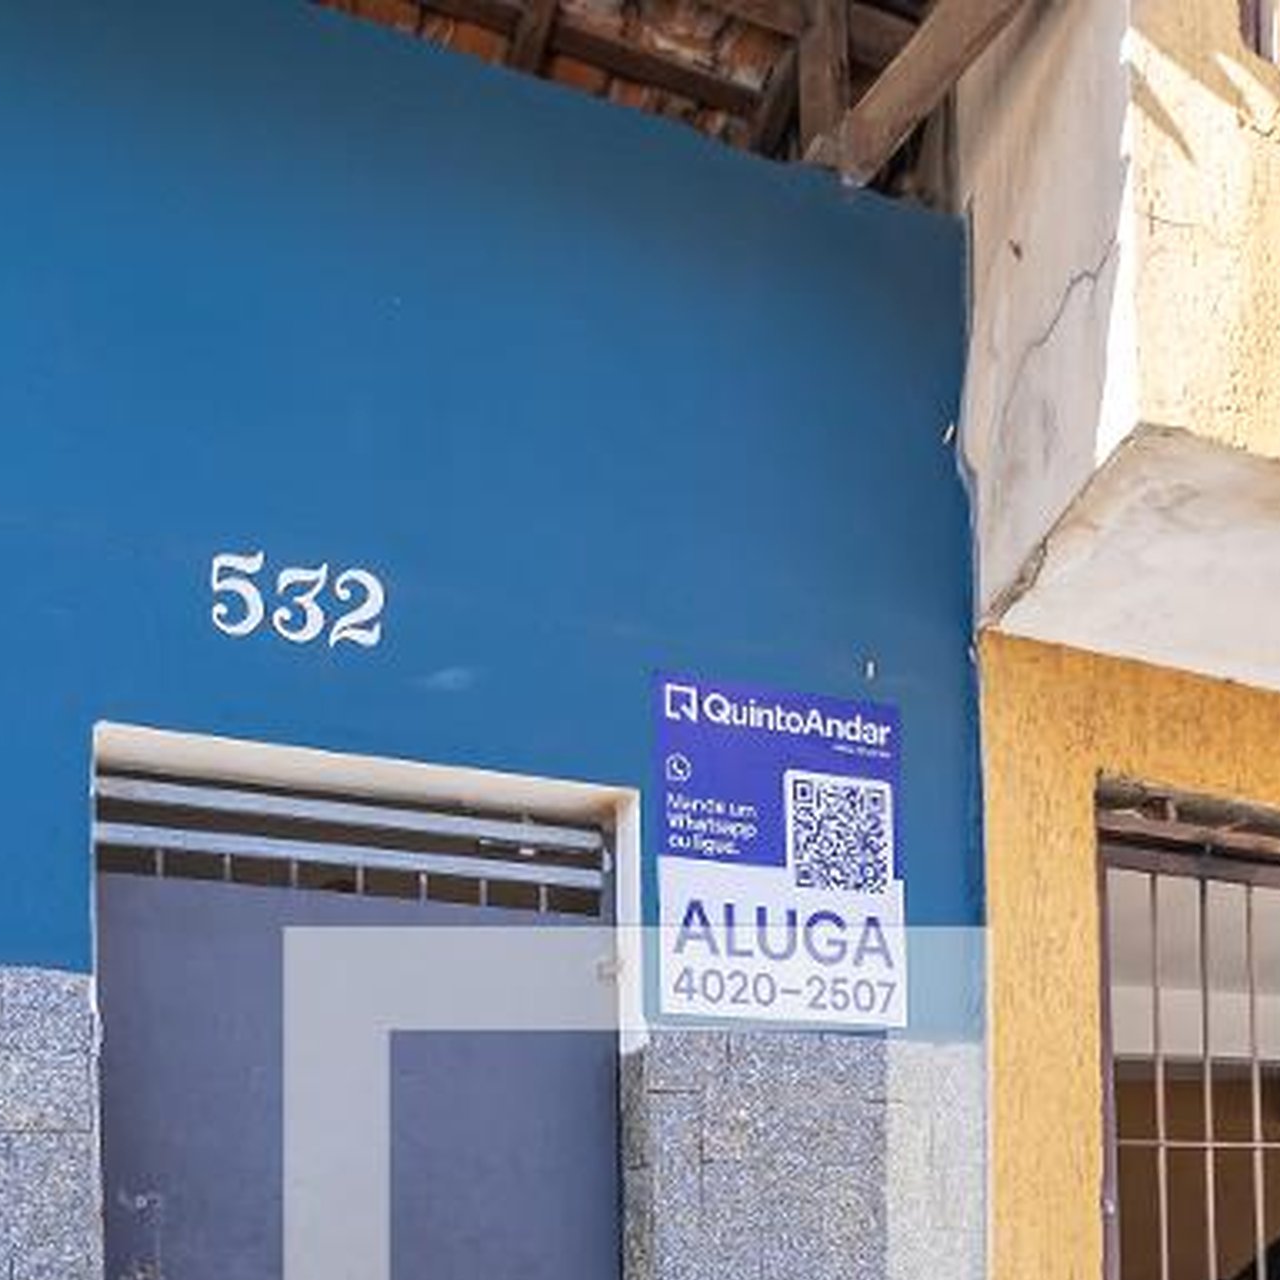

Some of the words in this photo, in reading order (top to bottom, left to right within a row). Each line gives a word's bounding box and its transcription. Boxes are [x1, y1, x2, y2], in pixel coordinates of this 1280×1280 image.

[209, 550, 386, 649] 532
[701, 692, 892, 746] QuintoAndar
[672, 898, 894, 970] ALUGA
[672, 967, 898, 1015] 4020-2507
